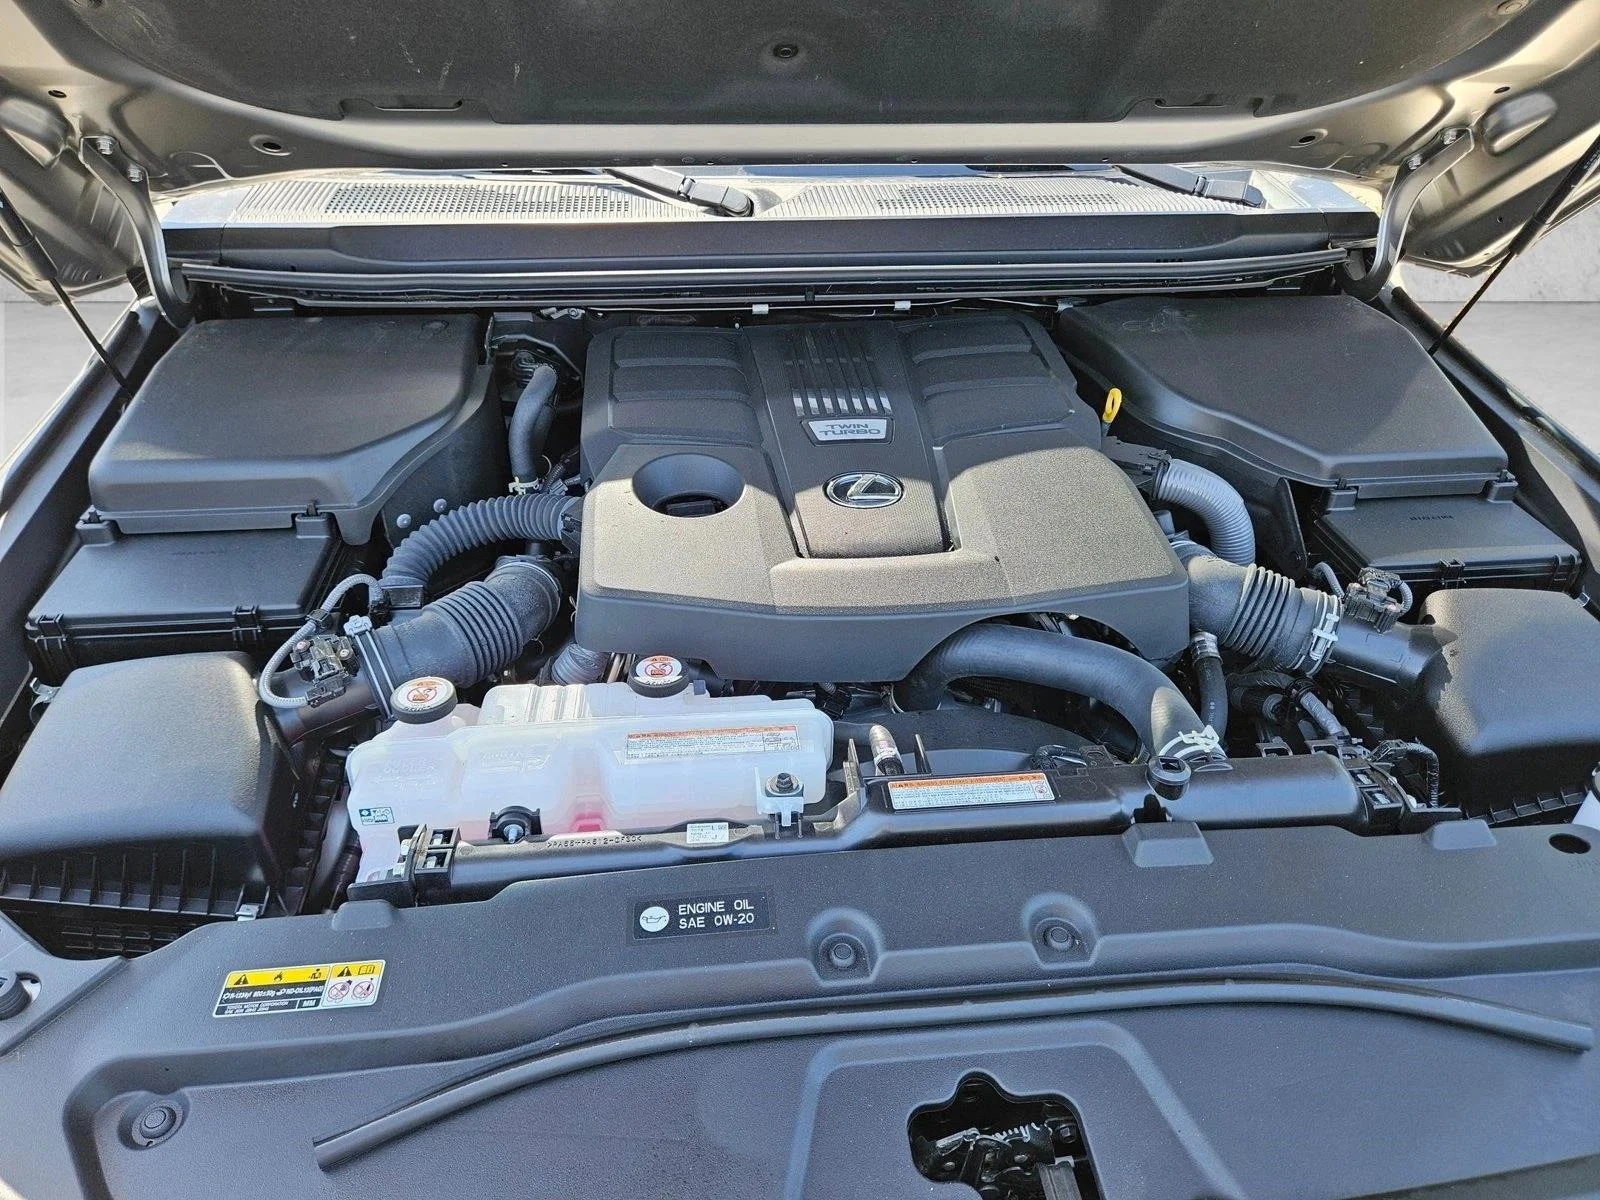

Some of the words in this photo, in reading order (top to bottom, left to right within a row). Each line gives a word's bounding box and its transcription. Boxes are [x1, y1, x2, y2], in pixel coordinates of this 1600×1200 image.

[678, 901, 725, 916] ENGINE
[733, 899, 755, 911] OIL
[678, 916, 706, 930] SAE
[714, 912, 755, 927] 0W-20
